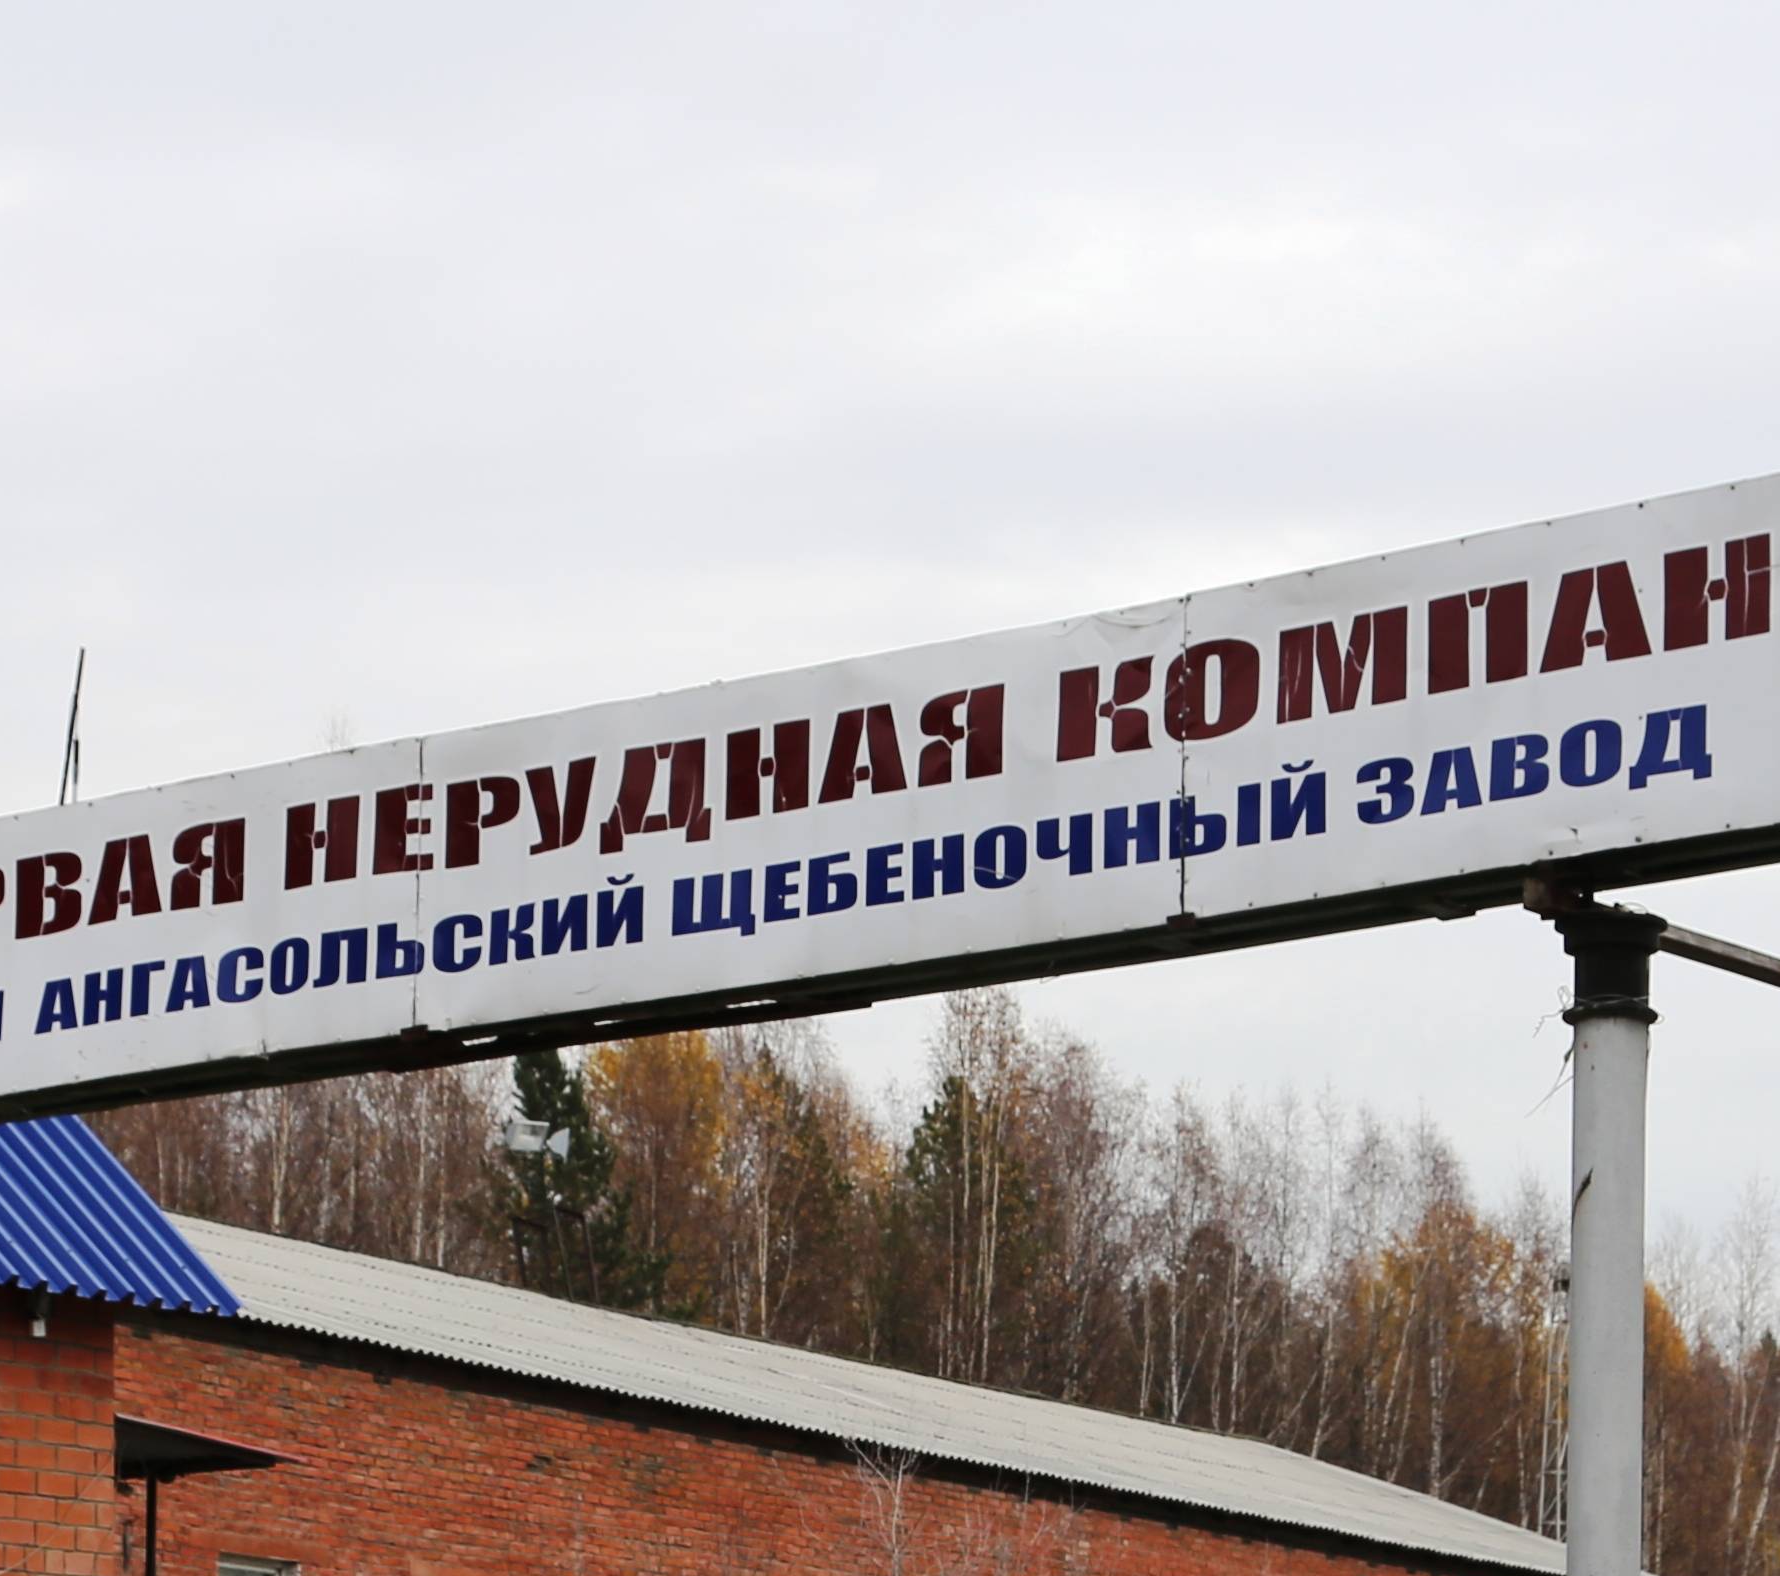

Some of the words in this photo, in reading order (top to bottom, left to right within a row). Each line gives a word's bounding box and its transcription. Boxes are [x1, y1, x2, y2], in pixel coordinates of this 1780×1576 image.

[33, 875, 644, 1036] АНГАСОЛЬСКИЙ
[671, 760, 1328, 937] ЩЕБЕНОЧНЫЙ
[1355, 703, 1712, 825] ЗАВОД
[284, 683, 1005, 890] НЕРУДНАЯ
